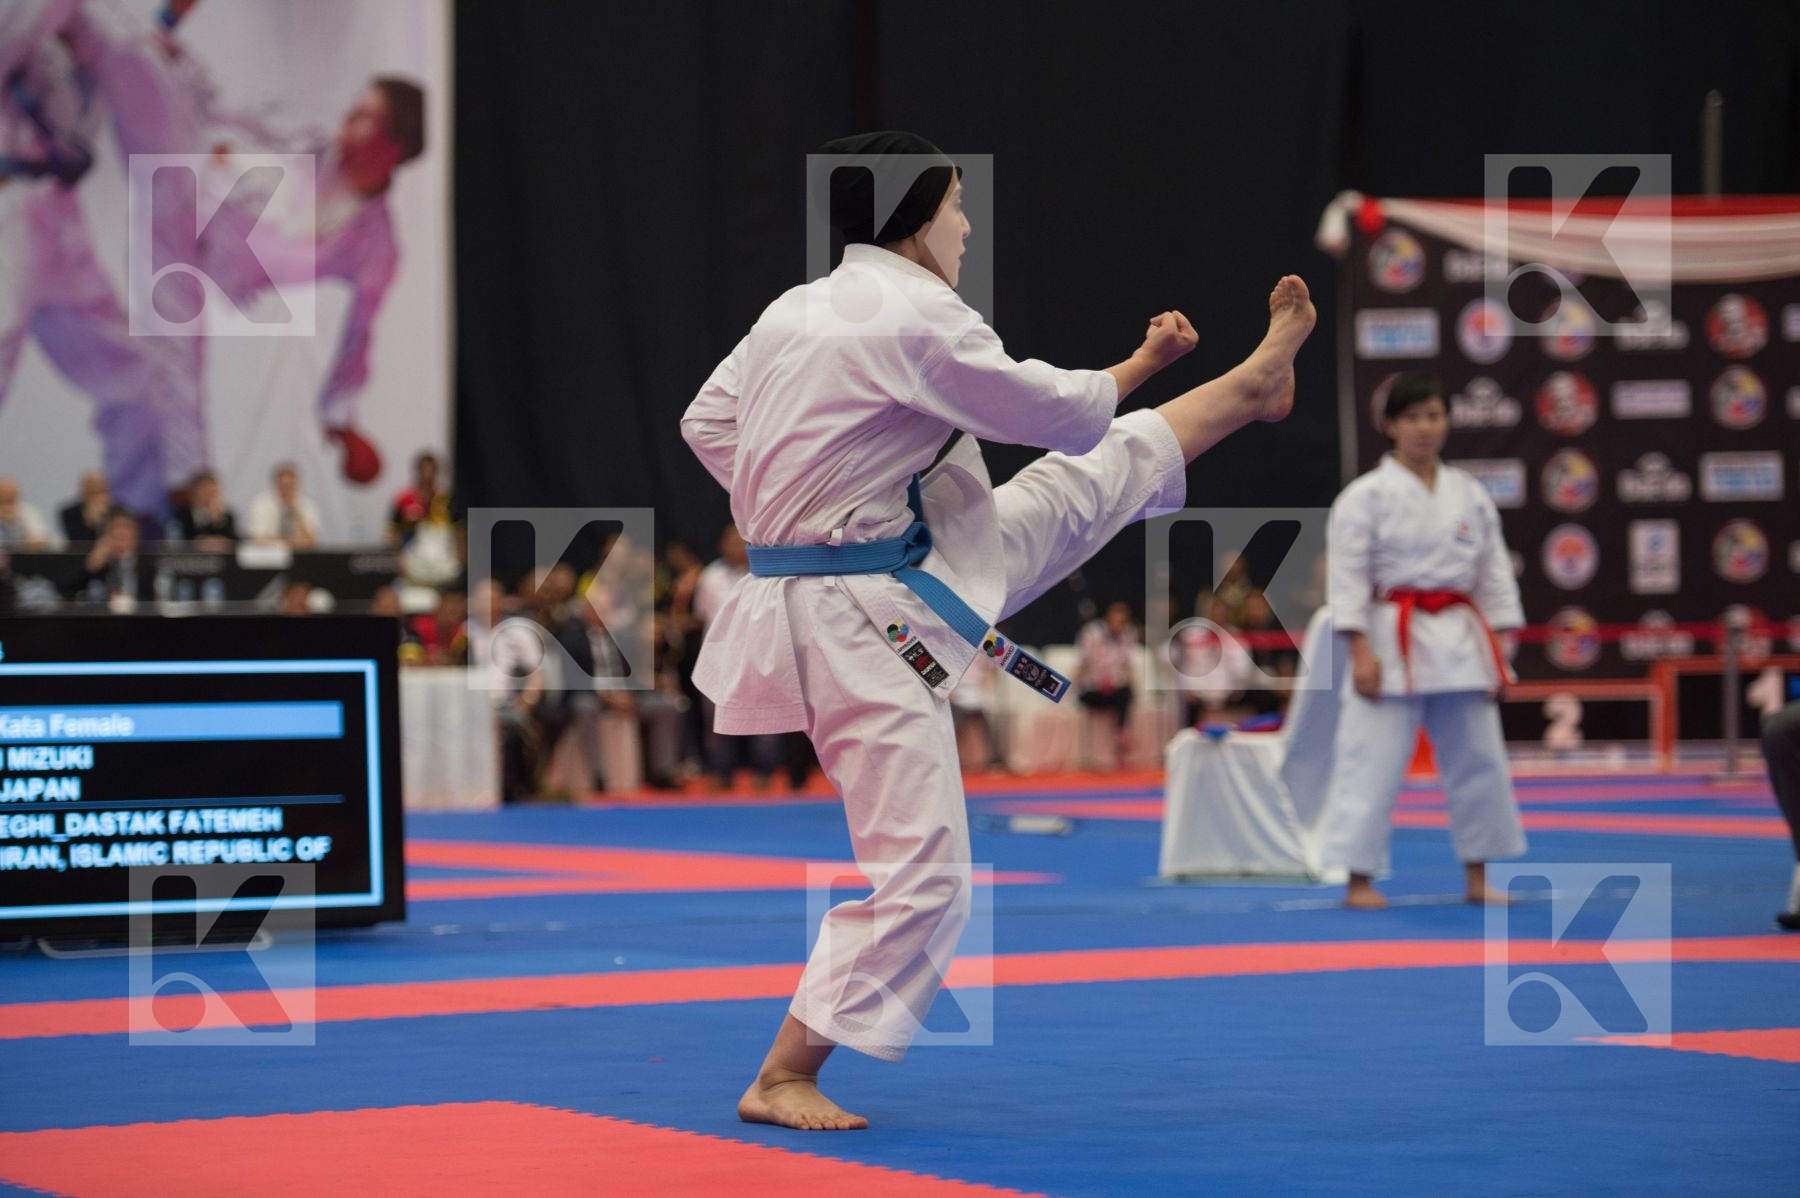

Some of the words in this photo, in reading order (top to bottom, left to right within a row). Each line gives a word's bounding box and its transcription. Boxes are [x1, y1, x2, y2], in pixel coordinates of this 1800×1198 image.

[50, 712, 135, 738] Female
[1542, 693, 1584, 750] 2
[7, 745, 94, 770] MIZUKI
[0, 777, 81, 802] JAPAN
[168, 806, 283, 834] FATEMEH
[0, 844, 67, 872] IRAN,
[70, 840, 169, 868] ISLAMIC
[172, 837, 293, 865] REPUBLIC
[295, 835, 332, 862] OF
